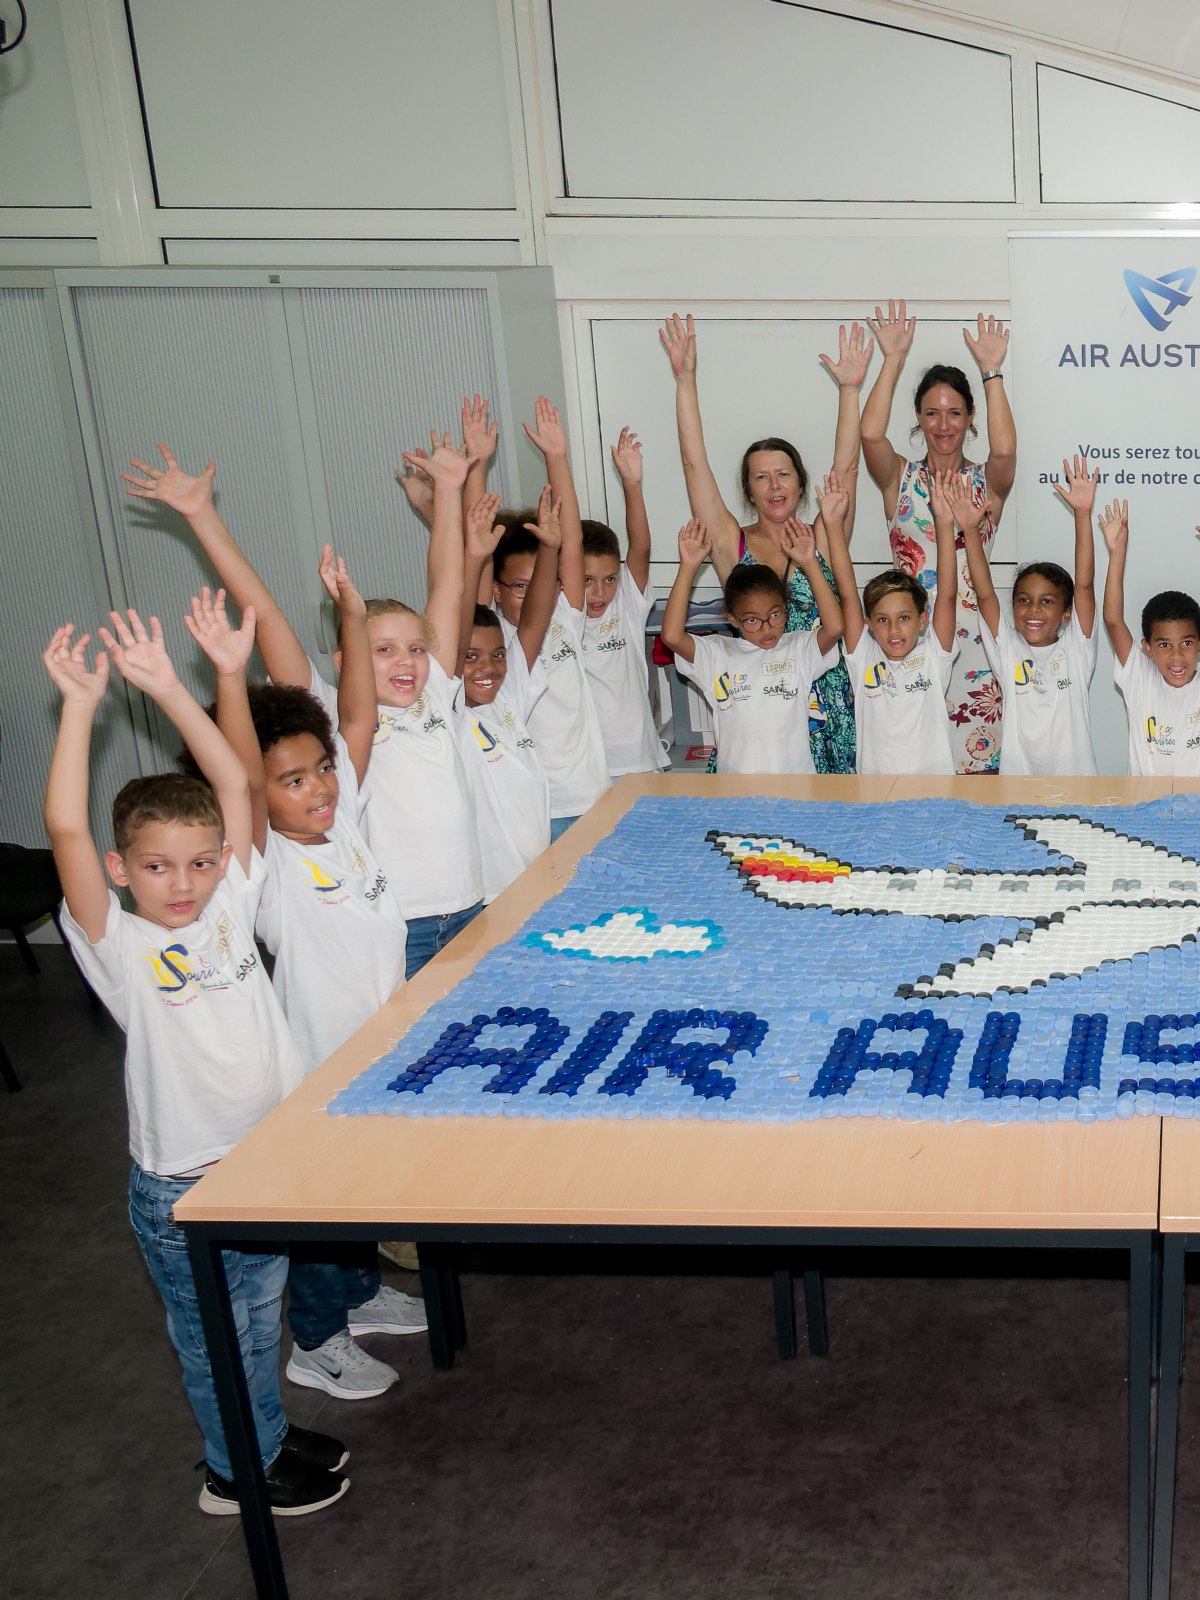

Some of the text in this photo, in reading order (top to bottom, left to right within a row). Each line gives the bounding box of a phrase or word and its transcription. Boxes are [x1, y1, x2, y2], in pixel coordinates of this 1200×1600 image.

[1058, 343, 1111, 368] AIR
[1078, 444, 1121, 460] Vous
[1125, 447, 1170, 460] serez
[1039, 472, 1060, 484] au
[1114, 469, 1136, 484] de
[1141, 471, 1188, 485] notre
[386, 1006, 768, 1100] AIR
